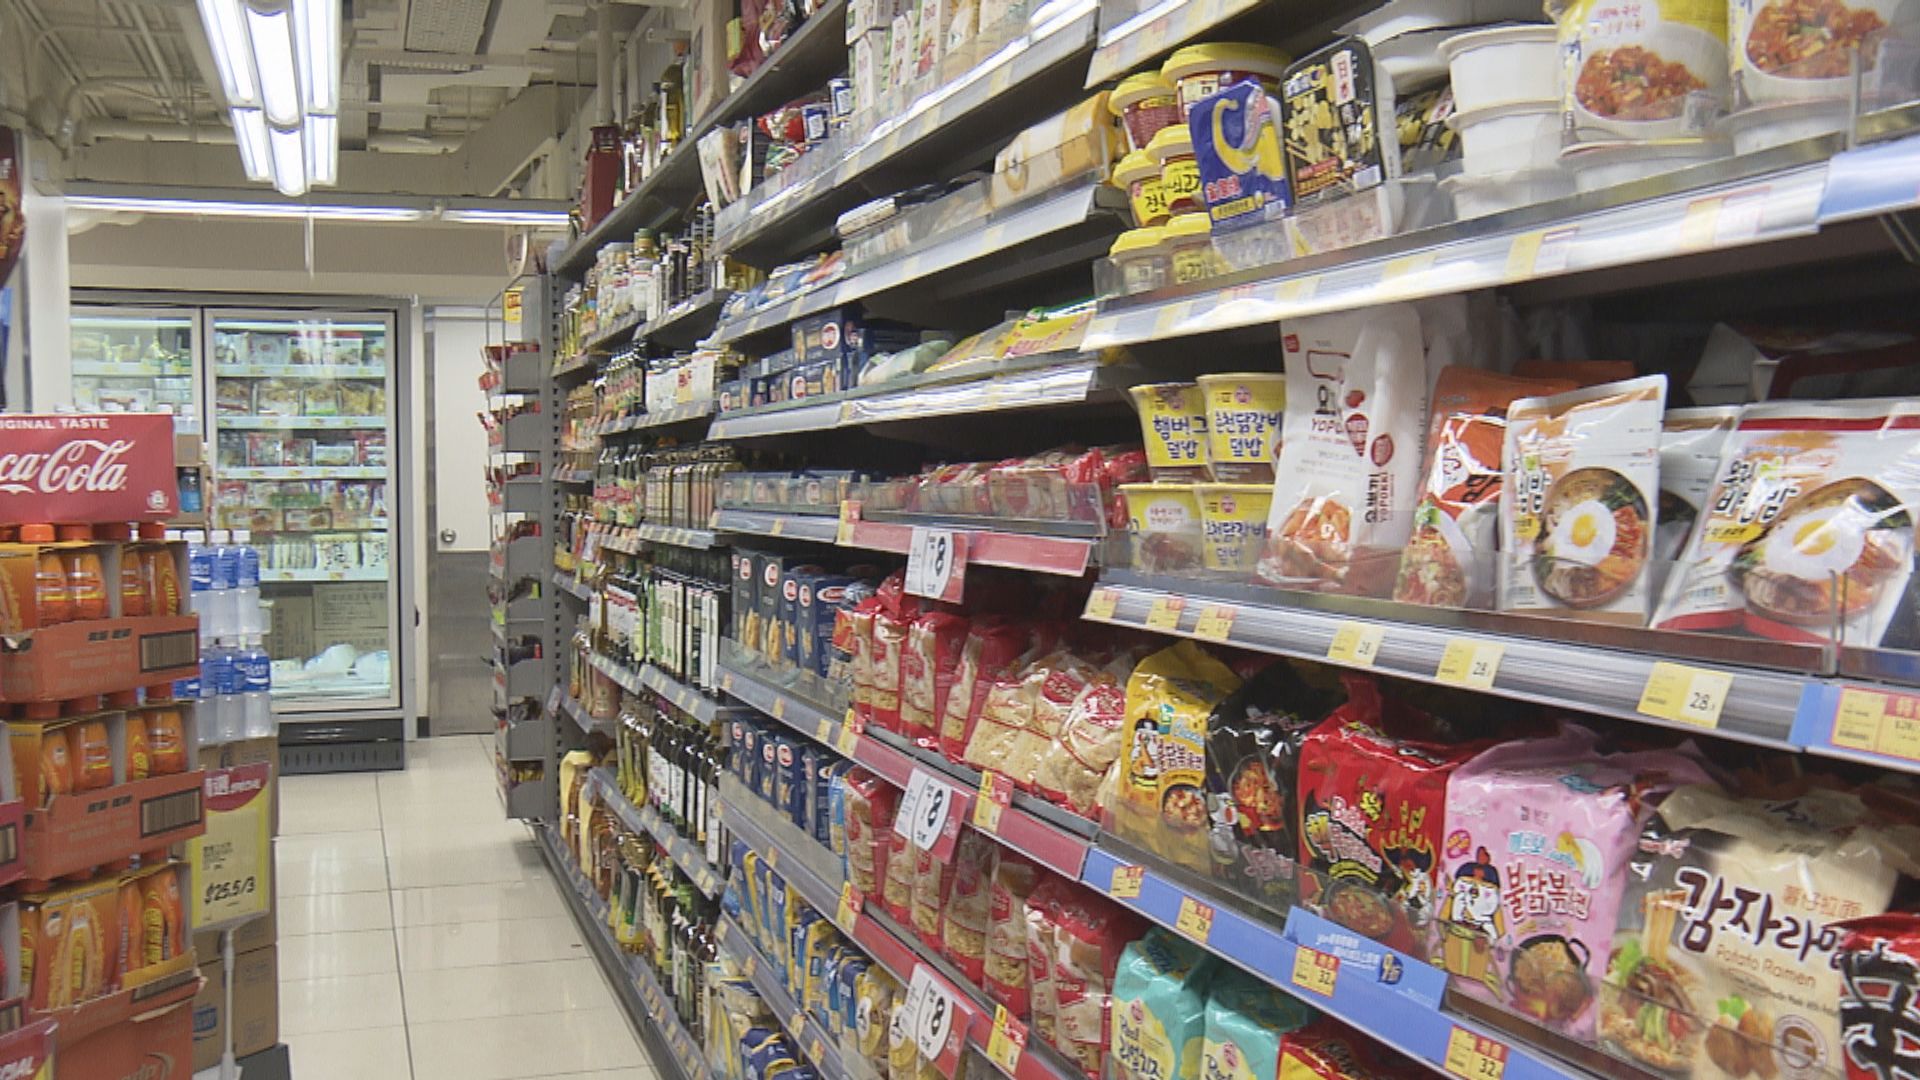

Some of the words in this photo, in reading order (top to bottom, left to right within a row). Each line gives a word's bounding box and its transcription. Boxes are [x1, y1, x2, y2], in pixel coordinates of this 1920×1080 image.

[59, 418, 110, 430] TASTE
[1229, 438, 1264, 458] 덮밥
[935, 535, 946, 576] 8
[1689, 691, 1710, 712] 28
[927, 790, 944, 828] 8
[1715, 944, 1758, 972] Potato
[1762, 958, 1817, 987] Ramen
[931, 996, 945, 1037] 8
[1479, 1057, 1497, 1077] 32
